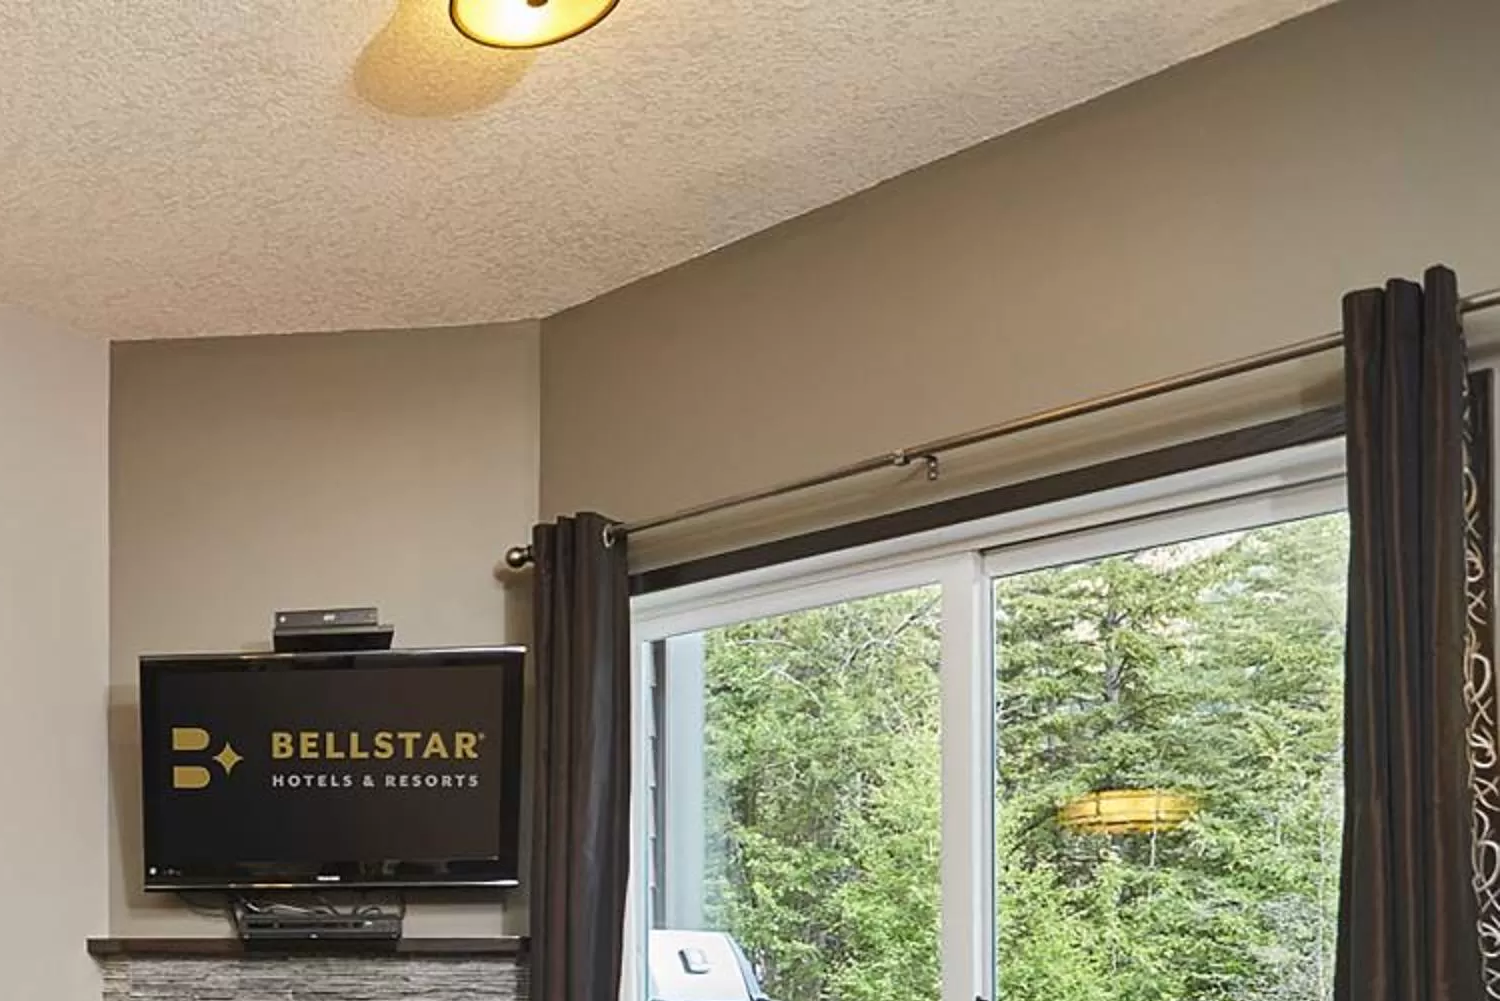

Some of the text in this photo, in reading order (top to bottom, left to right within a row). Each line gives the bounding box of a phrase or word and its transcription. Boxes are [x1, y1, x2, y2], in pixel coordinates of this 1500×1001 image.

[271, 731, 479, 759] BELLSTAR
[272, 774, 479, 788] HOTELS & RESORTS
